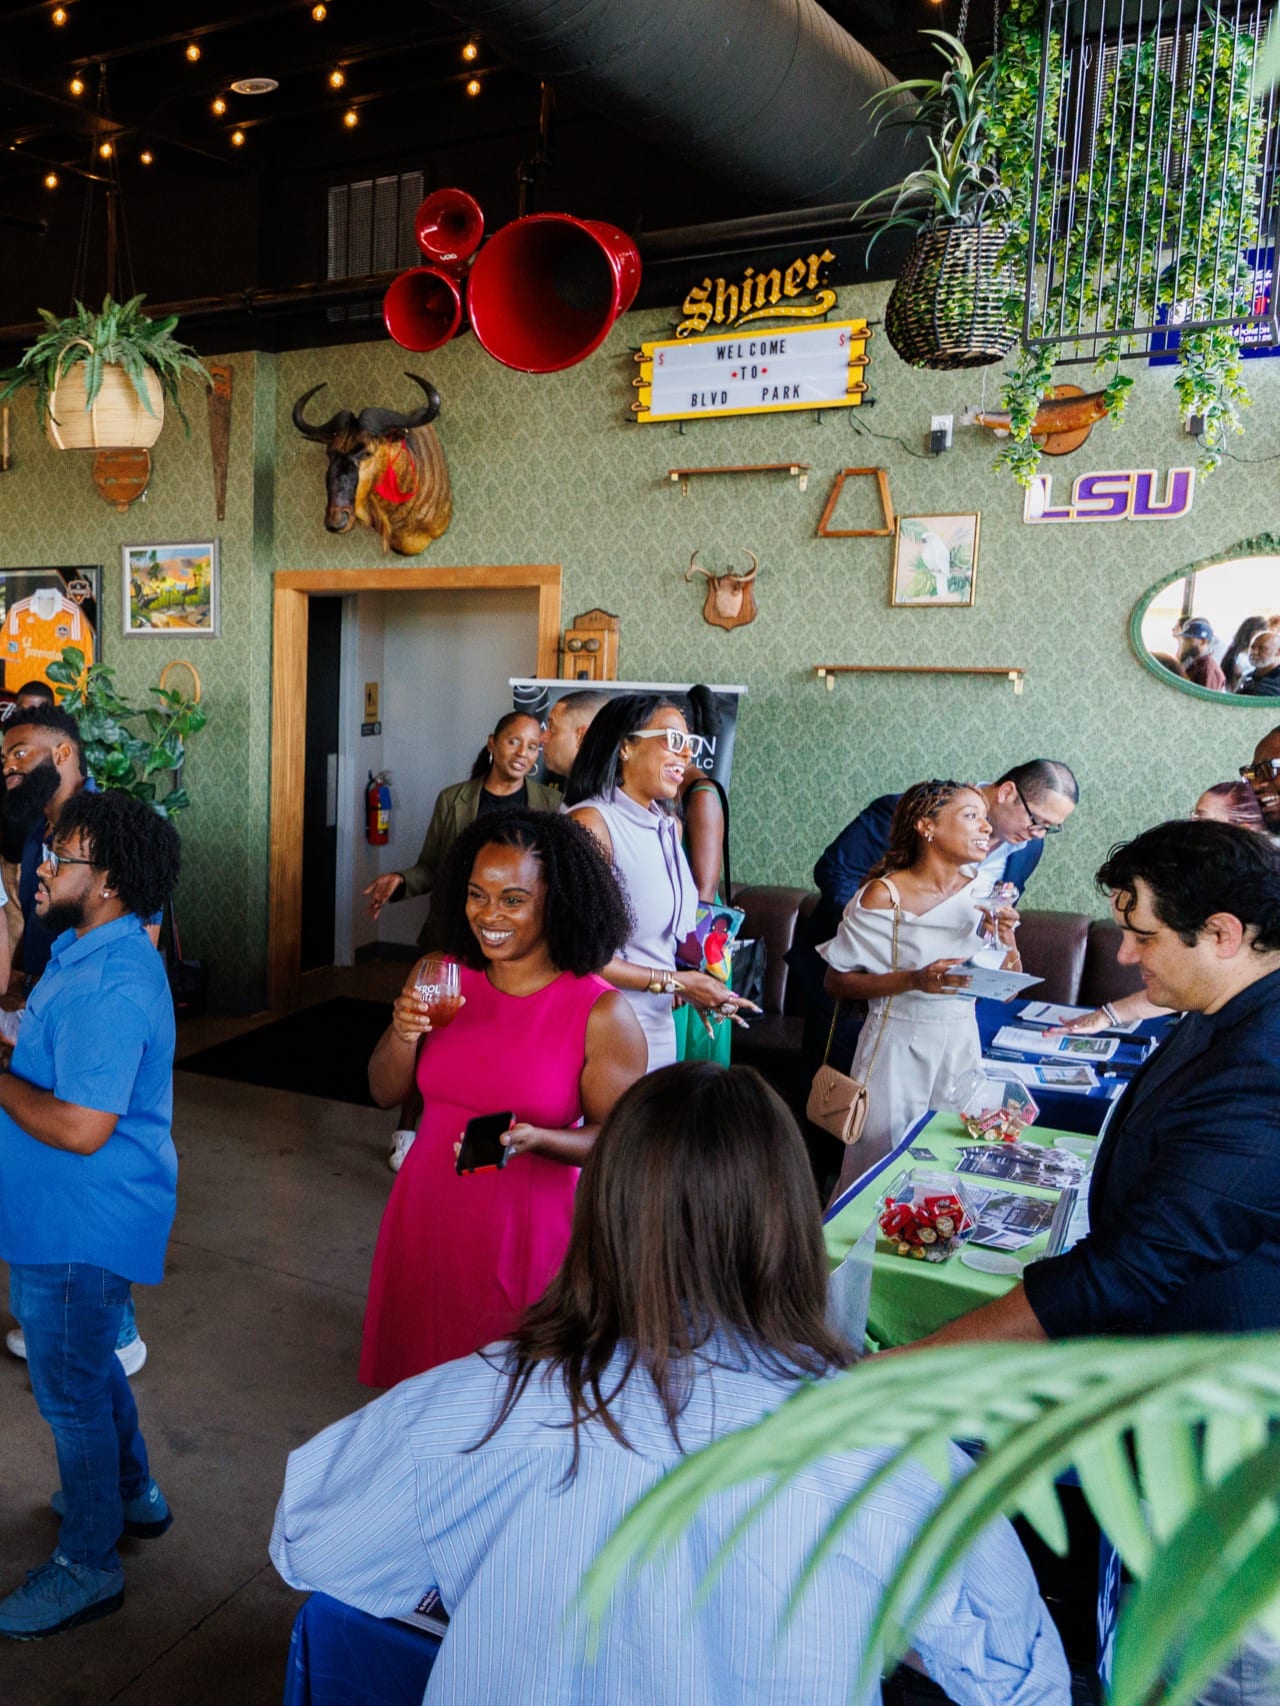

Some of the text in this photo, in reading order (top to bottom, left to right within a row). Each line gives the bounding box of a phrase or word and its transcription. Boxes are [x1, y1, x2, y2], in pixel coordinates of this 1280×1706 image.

[676, 249, 836, 339] Shiner
[717, 339, 786, 361] WELCOME
[741, 366, 758, 380] TO
[691, 385, 801, 408] BLVD PARK
[1023, 467, 1195, 524] LSU
[695, 758, 714, 770] LC
